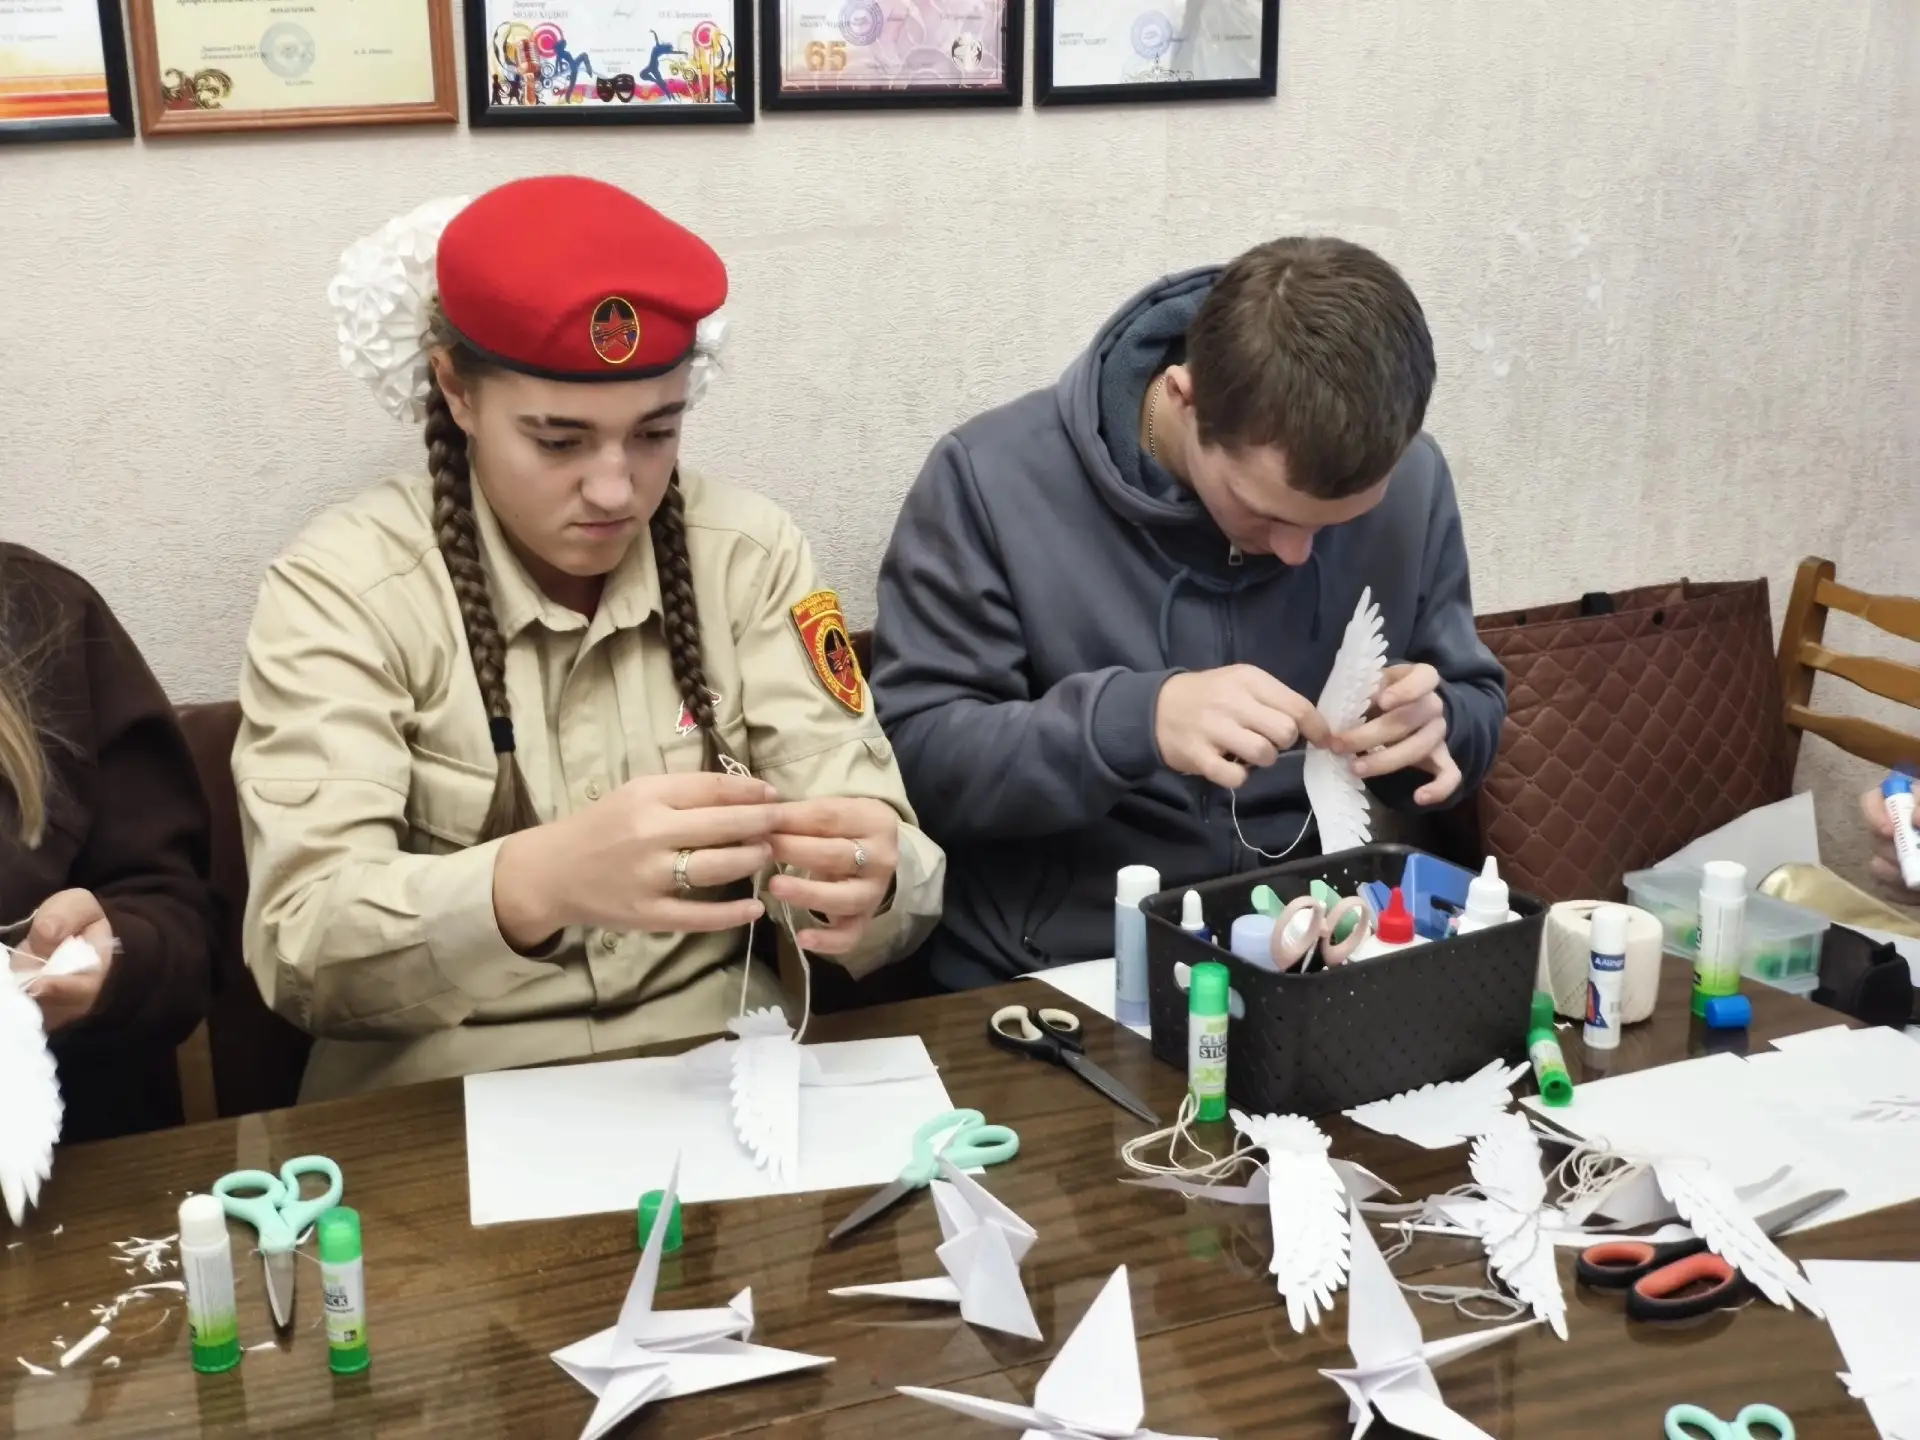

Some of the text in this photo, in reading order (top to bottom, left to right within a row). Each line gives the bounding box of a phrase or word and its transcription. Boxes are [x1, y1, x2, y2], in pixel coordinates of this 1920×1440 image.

[805, 41, 847, 71] 65
[1200, 1033, 1227, 1045] GLU
[1200, 1045, 1227, 1058] STIC
